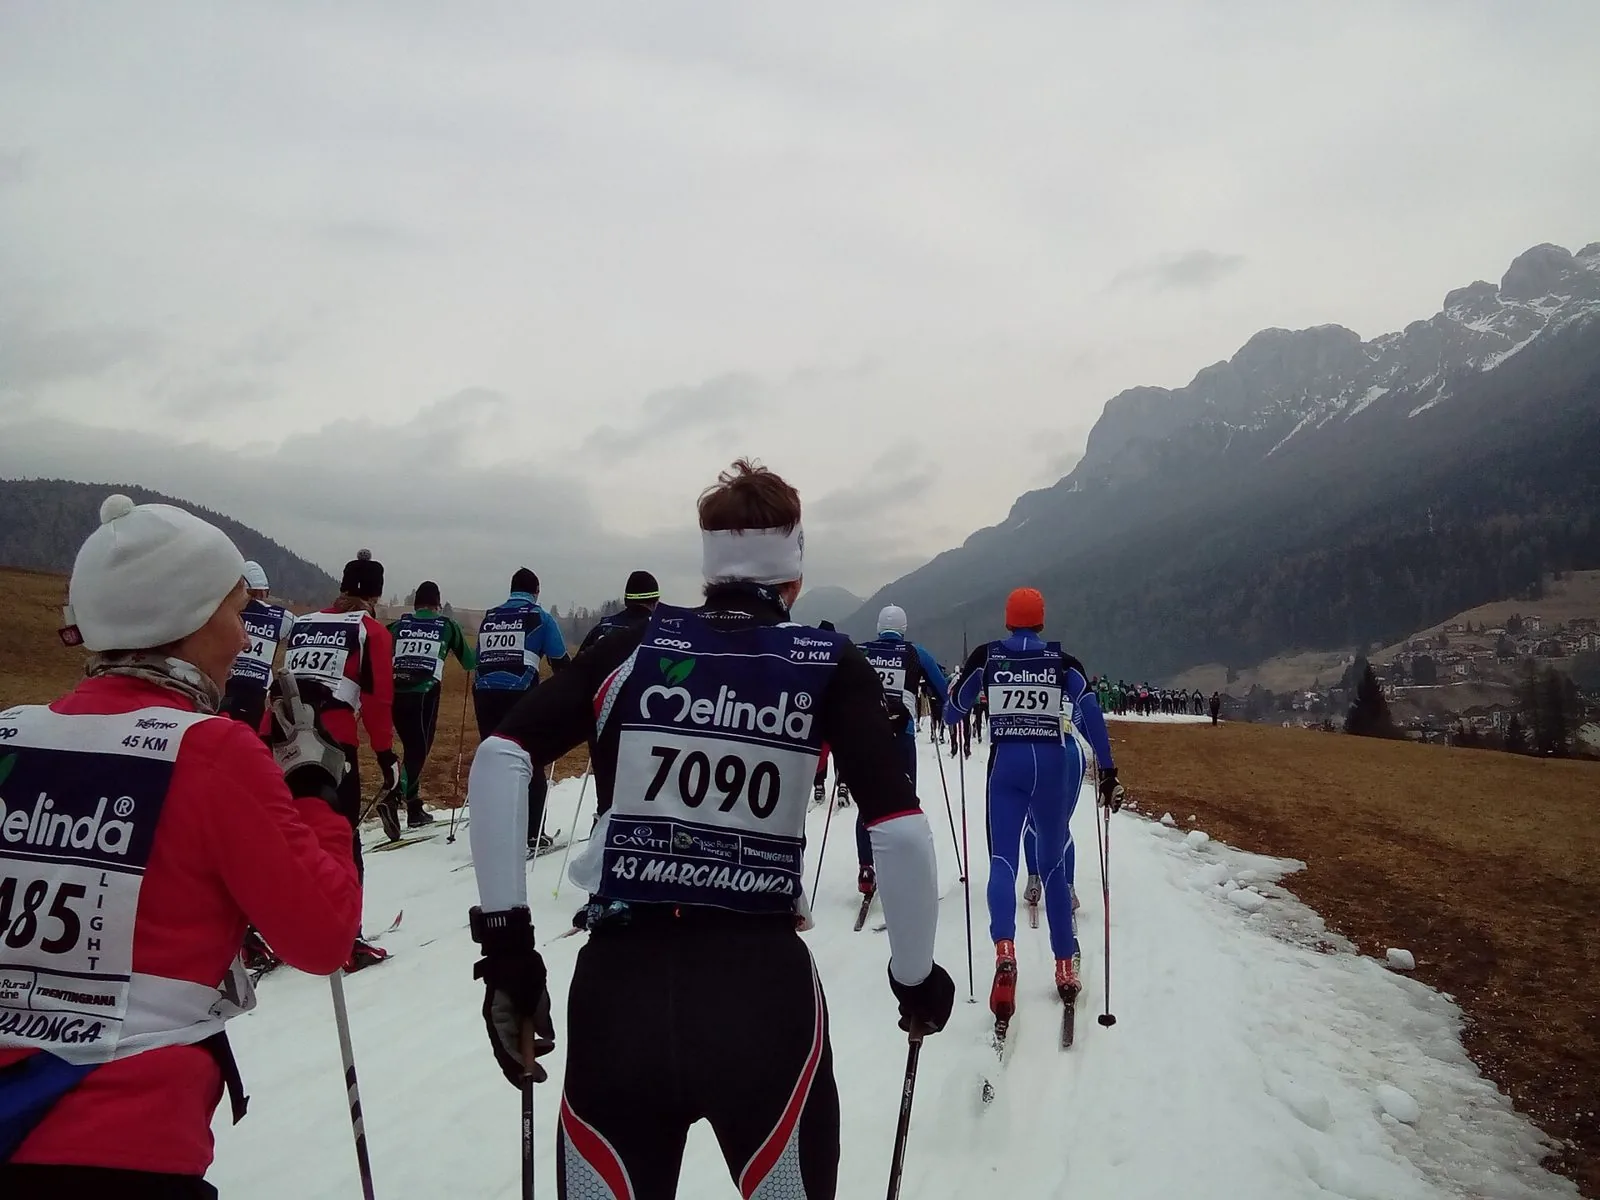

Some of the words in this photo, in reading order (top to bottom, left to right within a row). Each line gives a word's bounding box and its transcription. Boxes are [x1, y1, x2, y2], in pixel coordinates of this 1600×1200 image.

[245, 621, 275, 638] linda
[292, 631, 347, 646] Melinda
[486, 634, 516, 648] 6700
[654, 638, 692, 649] coop
[793, 636, 833, 647] TRENTINO
[401, 641, 432, 655] 7319
[789, 650, 805, 661] 70
[808, 651, 830, 661] KM
[291, 650, 334, 671] 6437
[1002, 690, 1049, 710] 7259
[134, 718, 178, 730] TRENTINO
[0, 727, 19, 740] op
[121, 735, 139, 748] 45
[142, 736, 169, 752] KM
[643, 745, 781, 819] 7090
[612, 834, 669, 849] CAVIT
[611, 855, 639, 881] 43
[87, 872, 109, 971] LIGHT
[2, 978, 32, 990] Rurali
